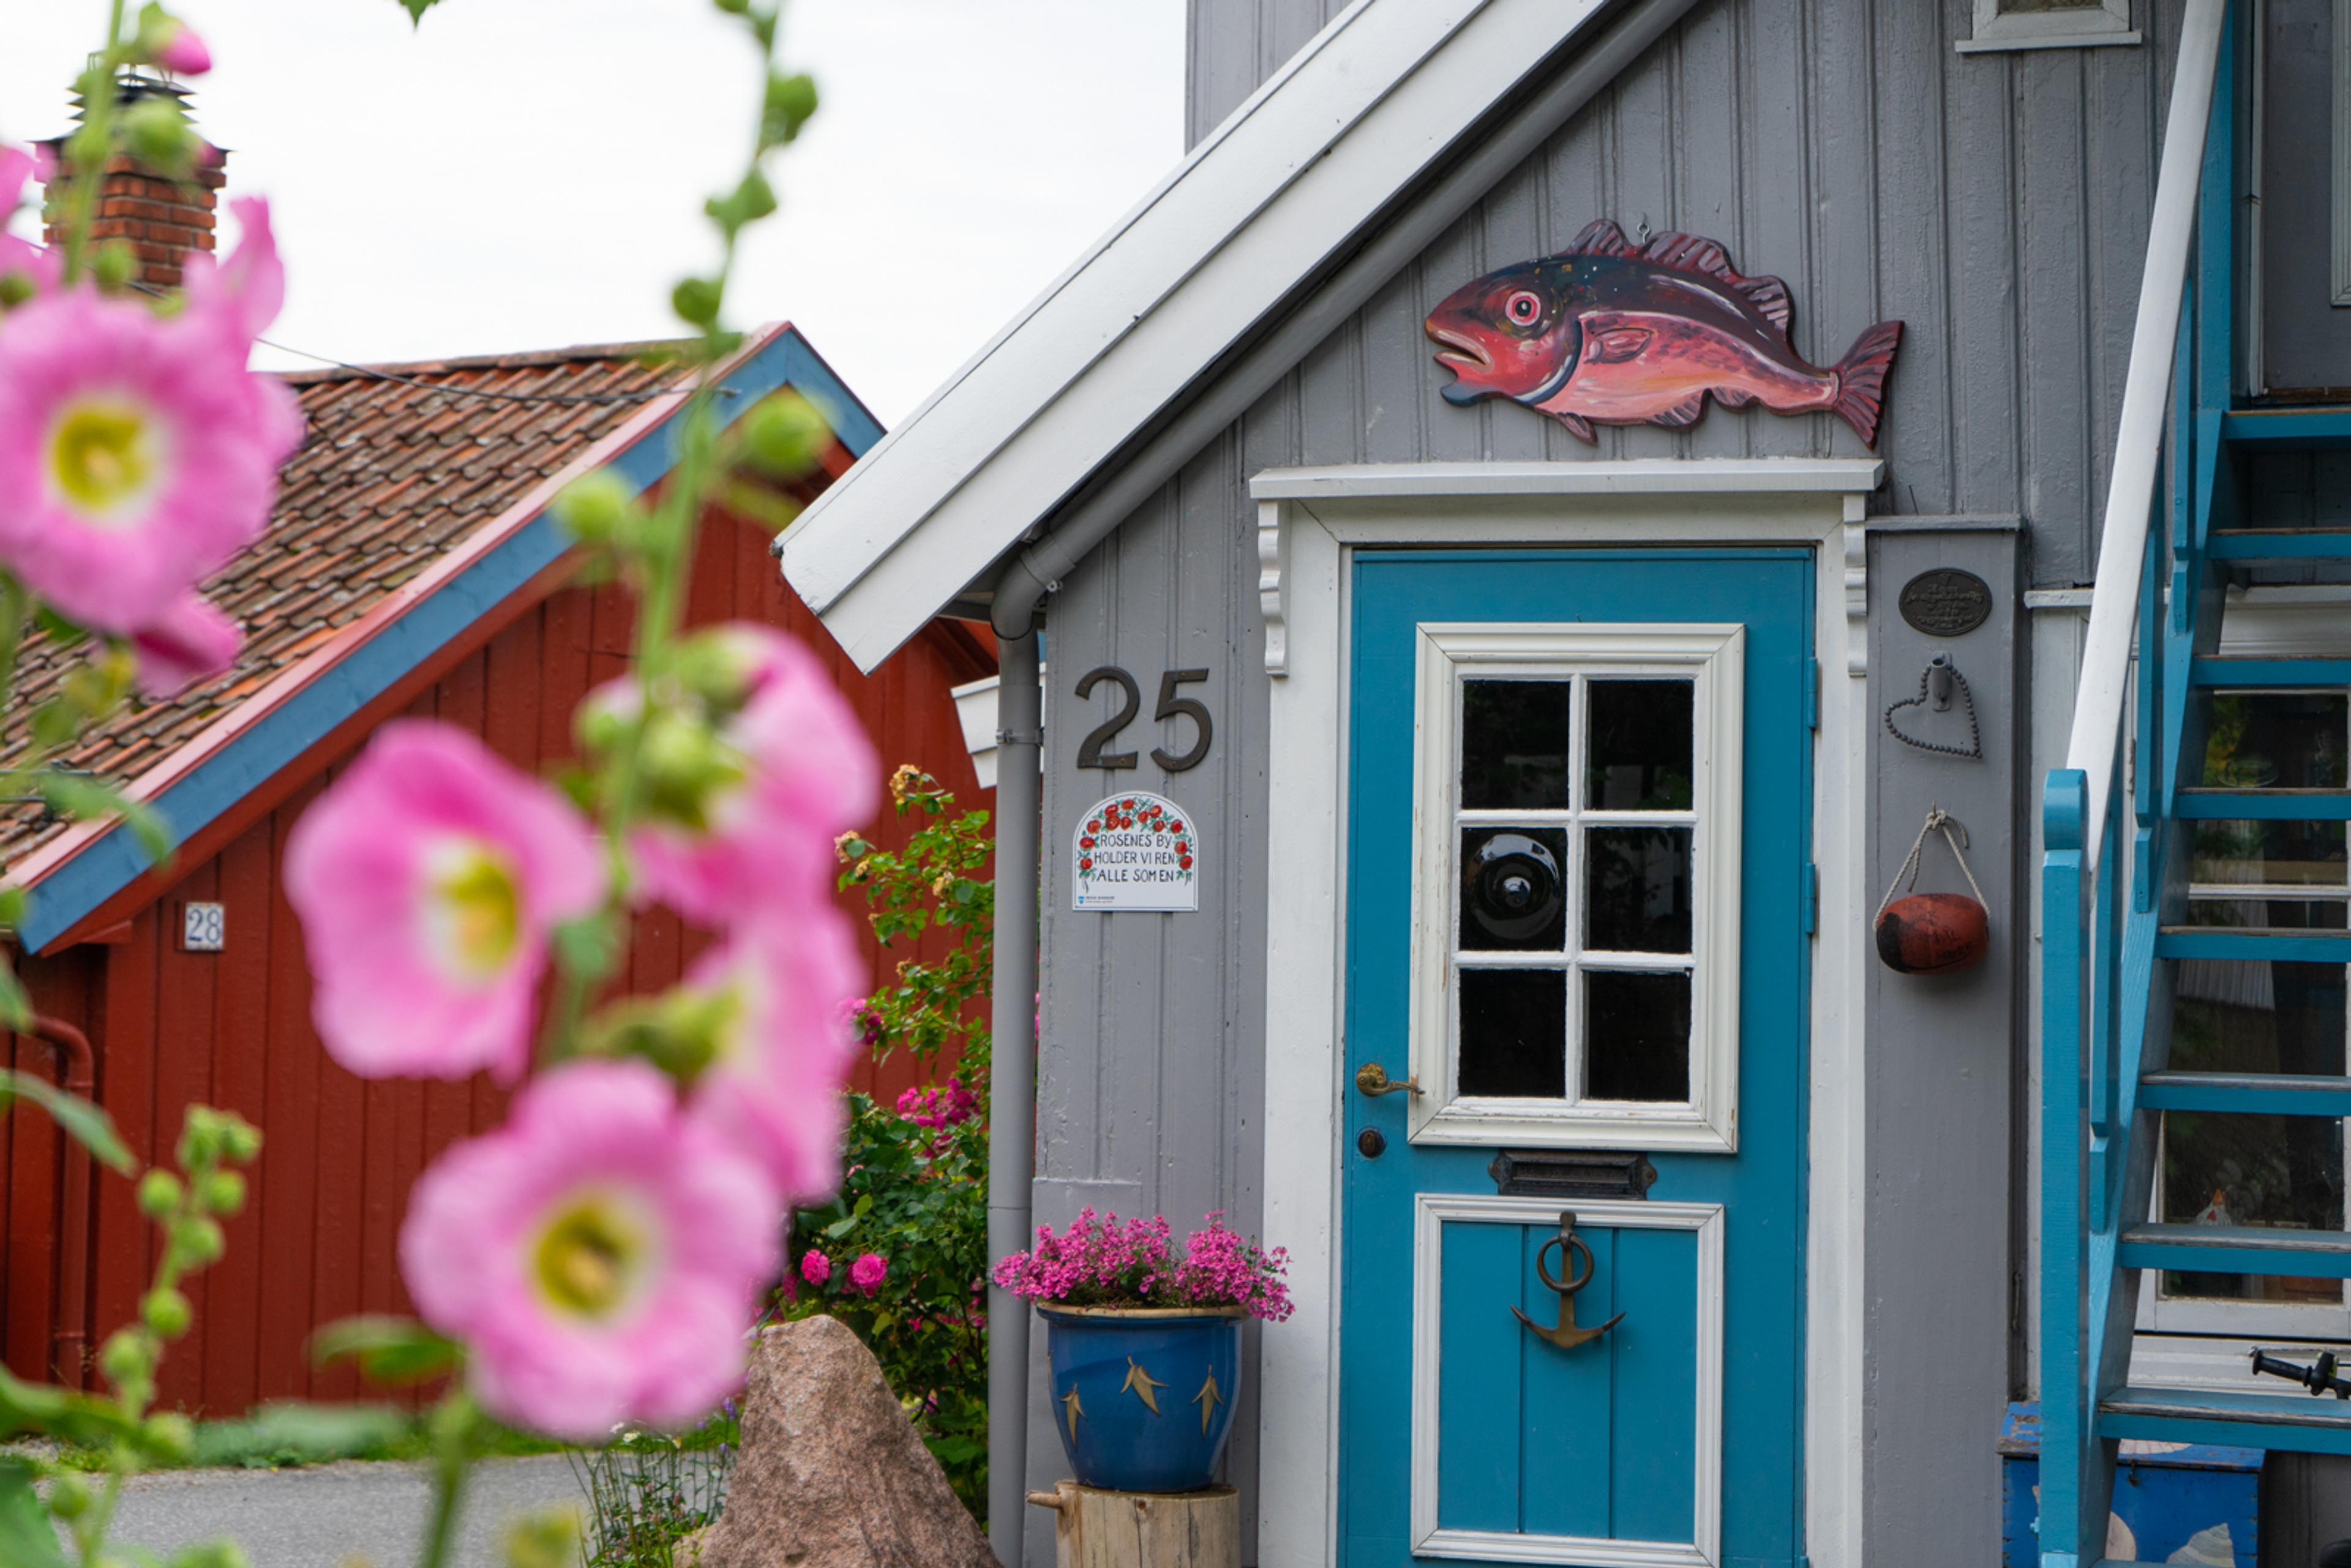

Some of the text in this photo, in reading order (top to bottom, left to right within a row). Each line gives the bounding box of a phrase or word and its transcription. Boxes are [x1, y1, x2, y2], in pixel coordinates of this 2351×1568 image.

[1074, 666, 1213, 772] 25
[1100, 833, 1152, 847] ROSENES
[1095, 850, 1175, 865] HOLDER VI REN
[1097, 869, 1128, 882] ALLE
[189, 909, 221, 943] 28
